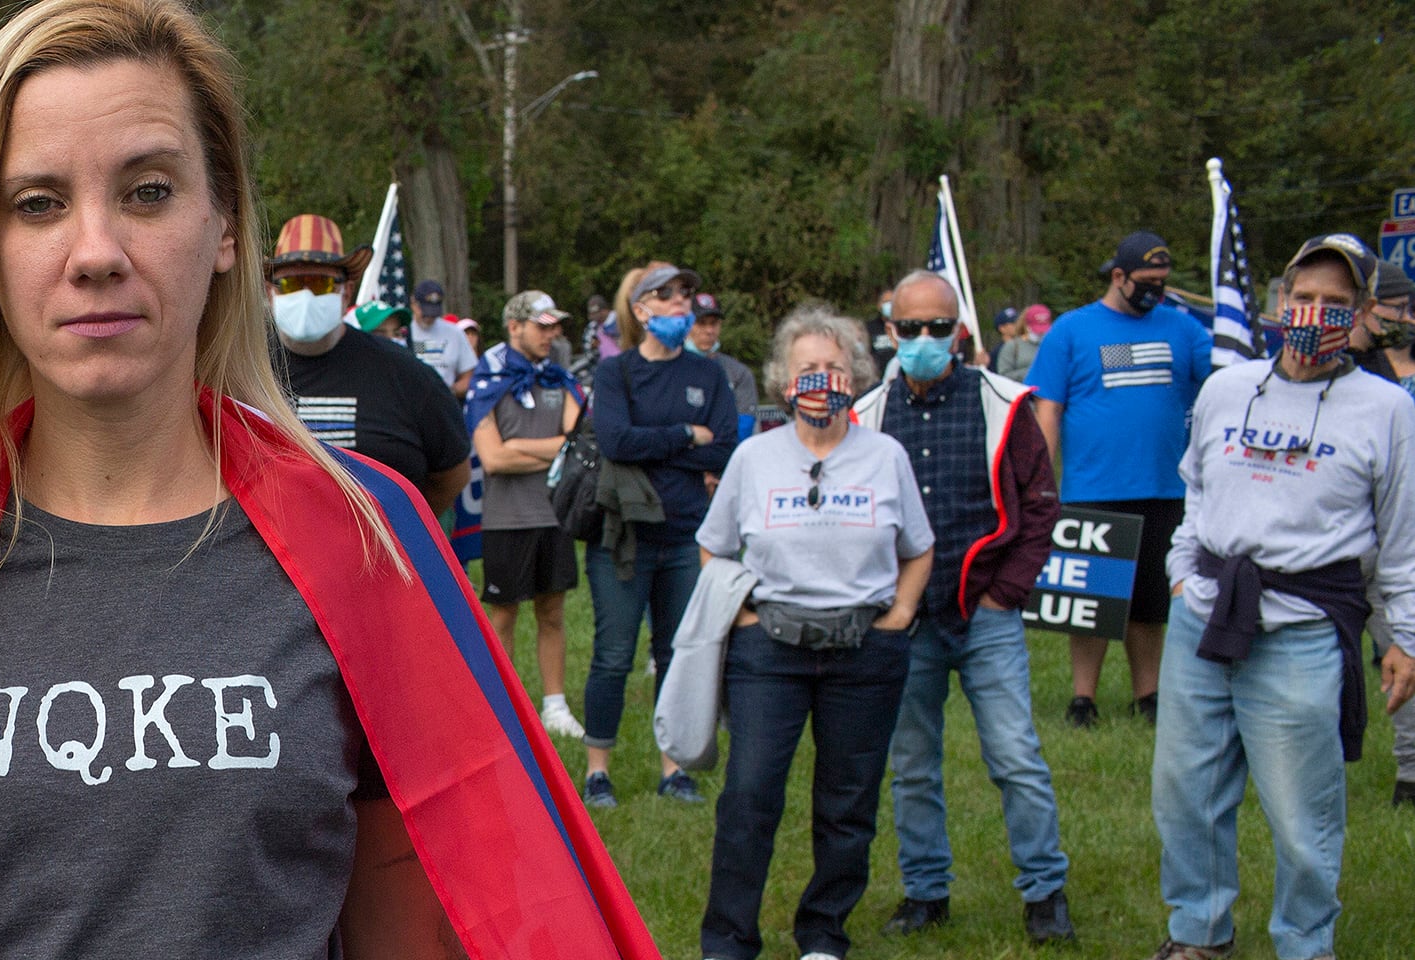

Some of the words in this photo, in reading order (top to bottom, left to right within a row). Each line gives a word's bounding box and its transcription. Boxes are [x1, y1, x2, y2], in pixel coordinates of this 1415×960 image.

[1397, 194, 1415, 215] EA
[1387, 238, 1415, 268] 49
[1051, 518, 1112, 552] CK
[1036, 556, 1090, 589] HE
